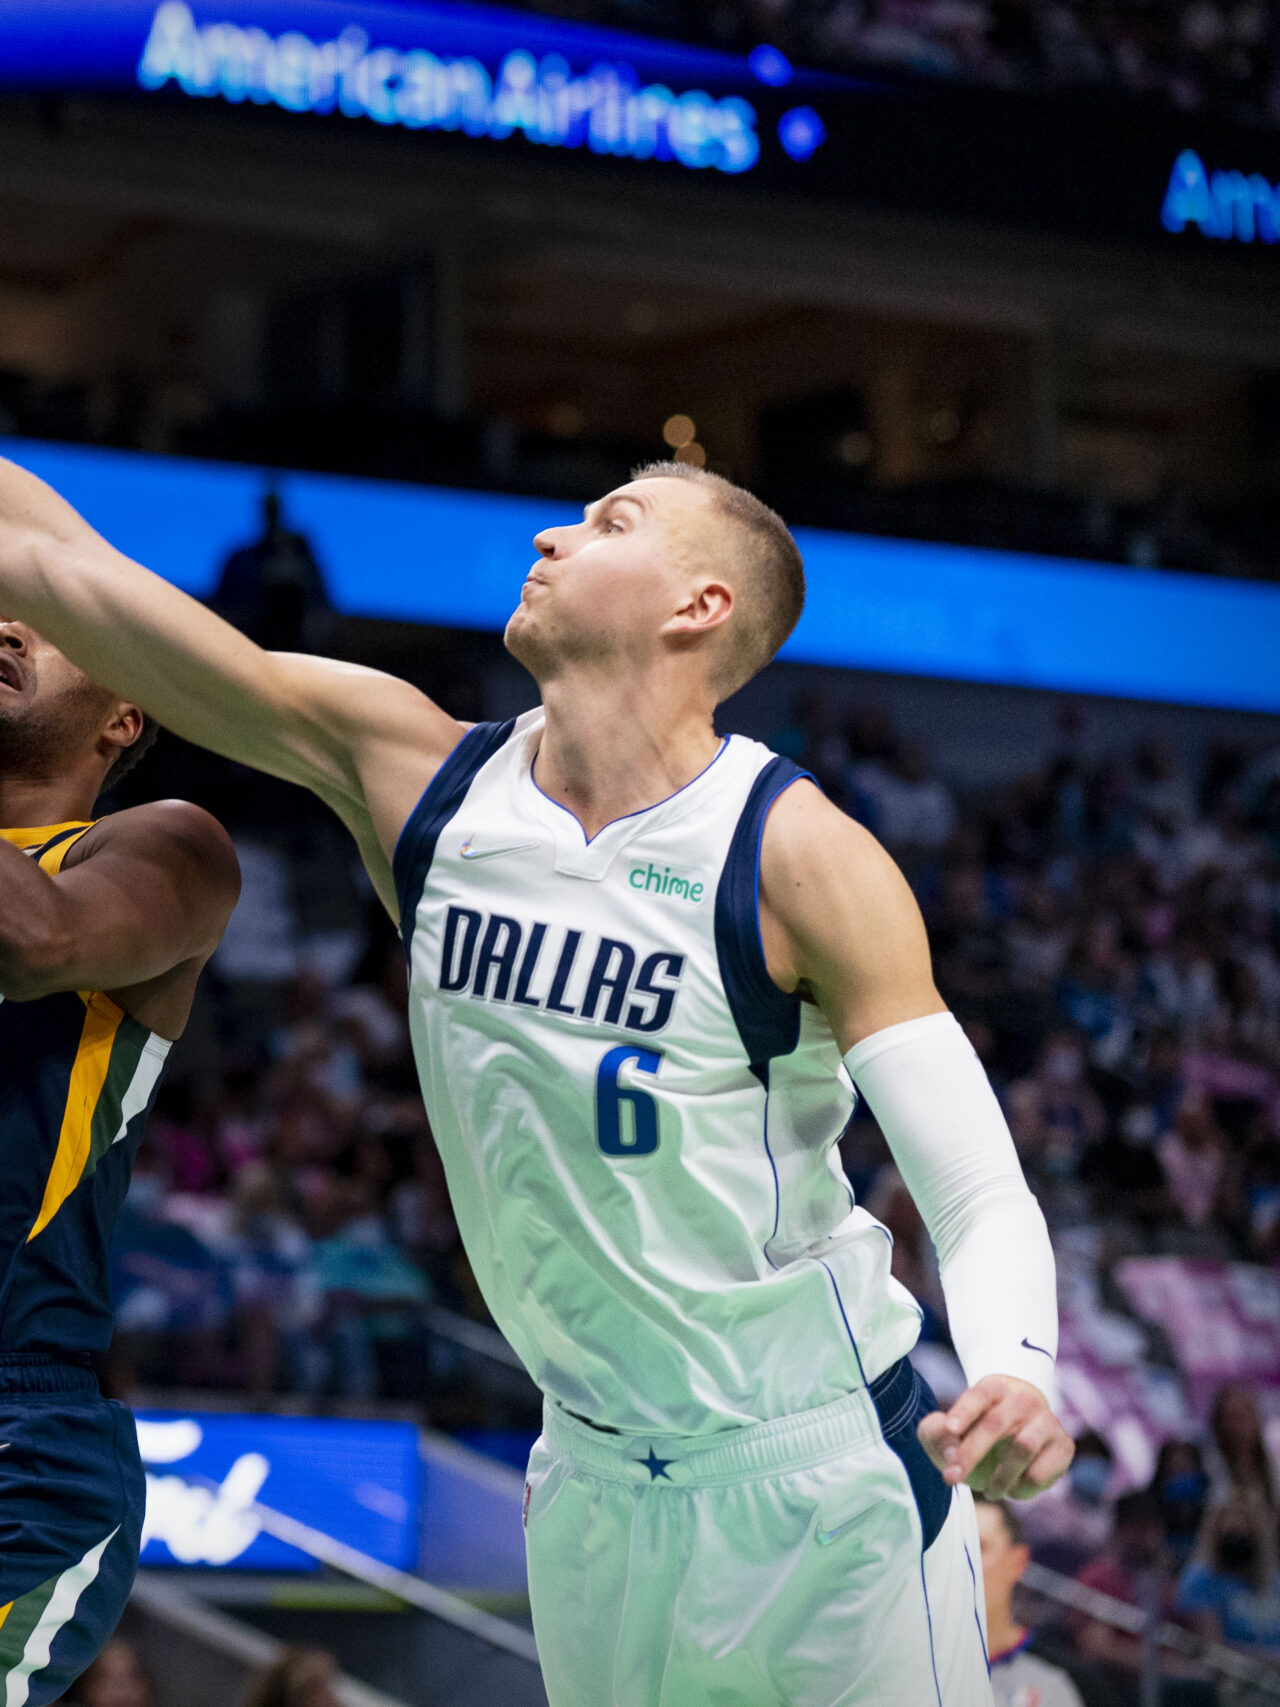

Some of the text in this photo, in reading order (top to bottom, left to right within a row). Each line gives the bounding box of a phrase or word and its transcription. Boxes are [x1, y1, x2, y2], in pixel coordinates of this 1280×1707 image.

[1160, 148, 1280, 246] Am
[629, 863, 704, 903] chime
[438, 905, 687, 1035] DALLAS
[596, 1043, 665, 1158] 6
